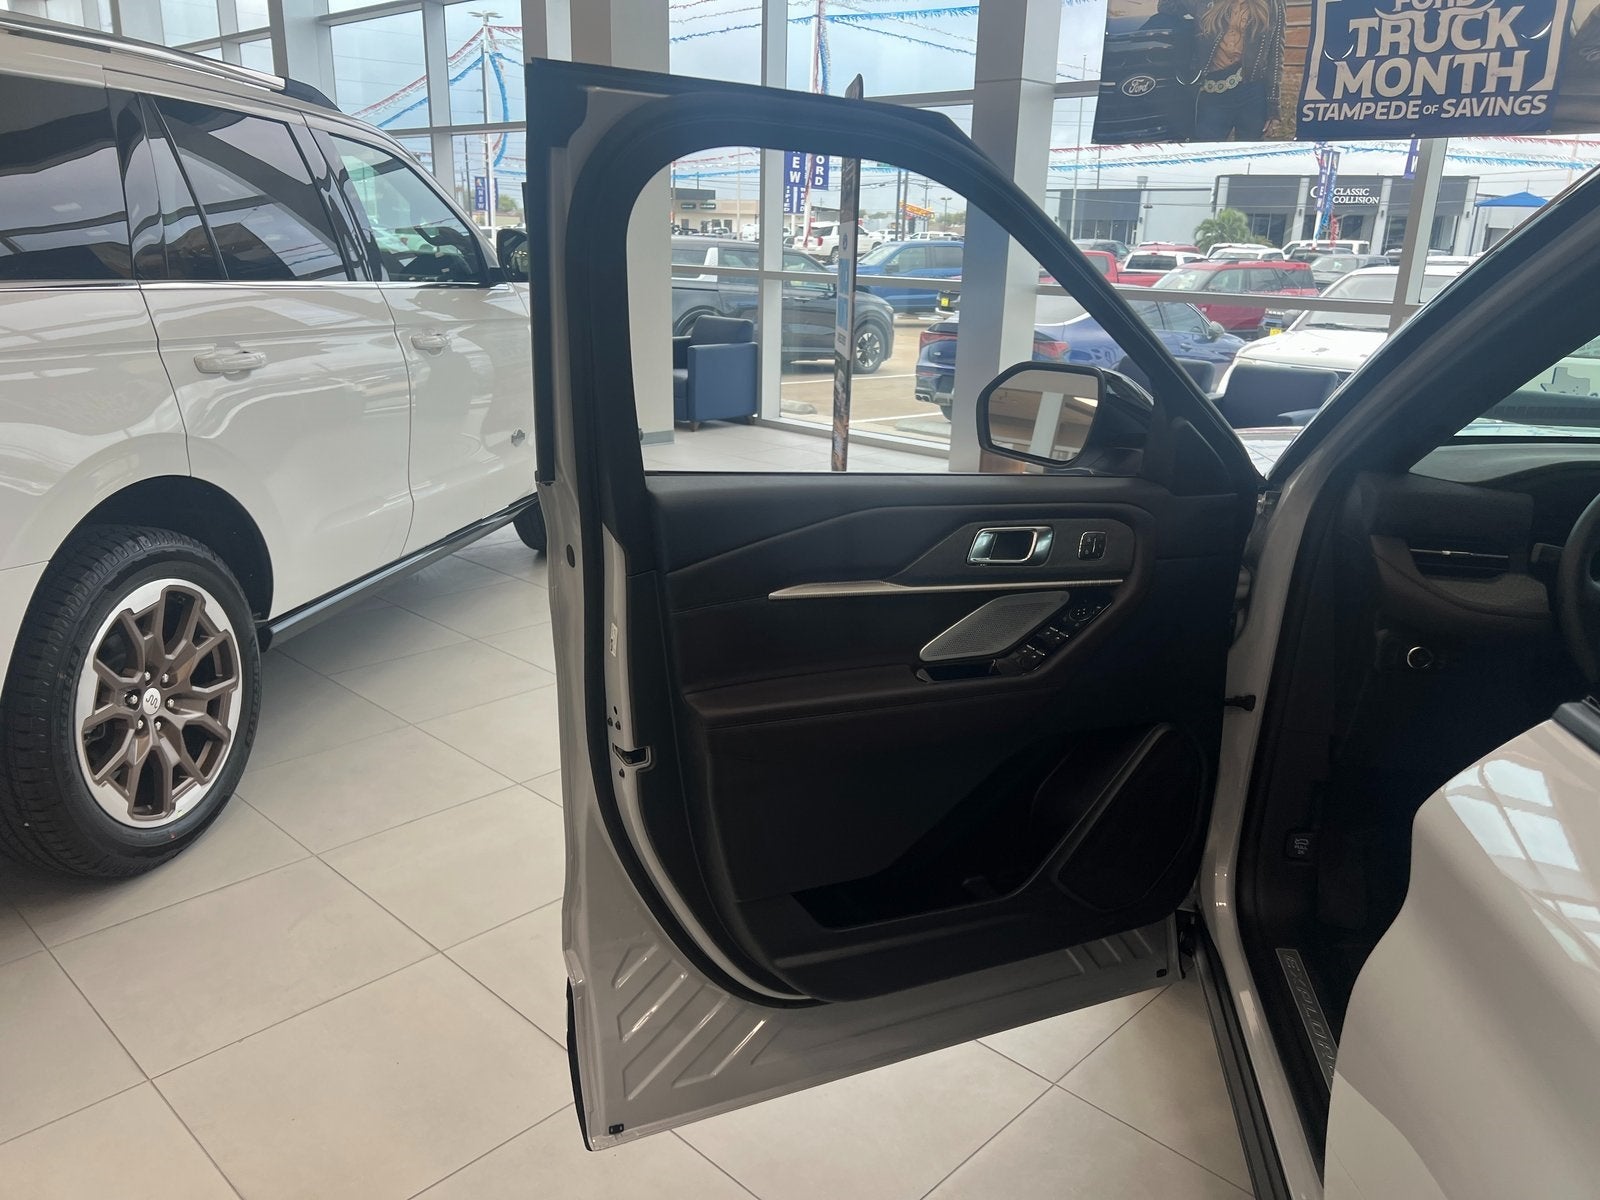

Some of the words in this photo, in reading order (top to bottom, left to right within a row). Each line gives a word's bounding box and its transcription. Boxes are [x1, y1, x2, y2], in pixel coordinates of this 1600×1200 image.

[1349, 4, 1525, 58] TRUCK
[1334, 50, 1530, 99] MONTH
[1302, 100, 1420, 122] STAMPEDE
[1422, 103, 1440, 116] OF
[1440, 94, 1548, 118] SAVINGS
[1332, 196, 1380, 204] COLLISION
[1333, 187, 1370, 196] CLASSIC
